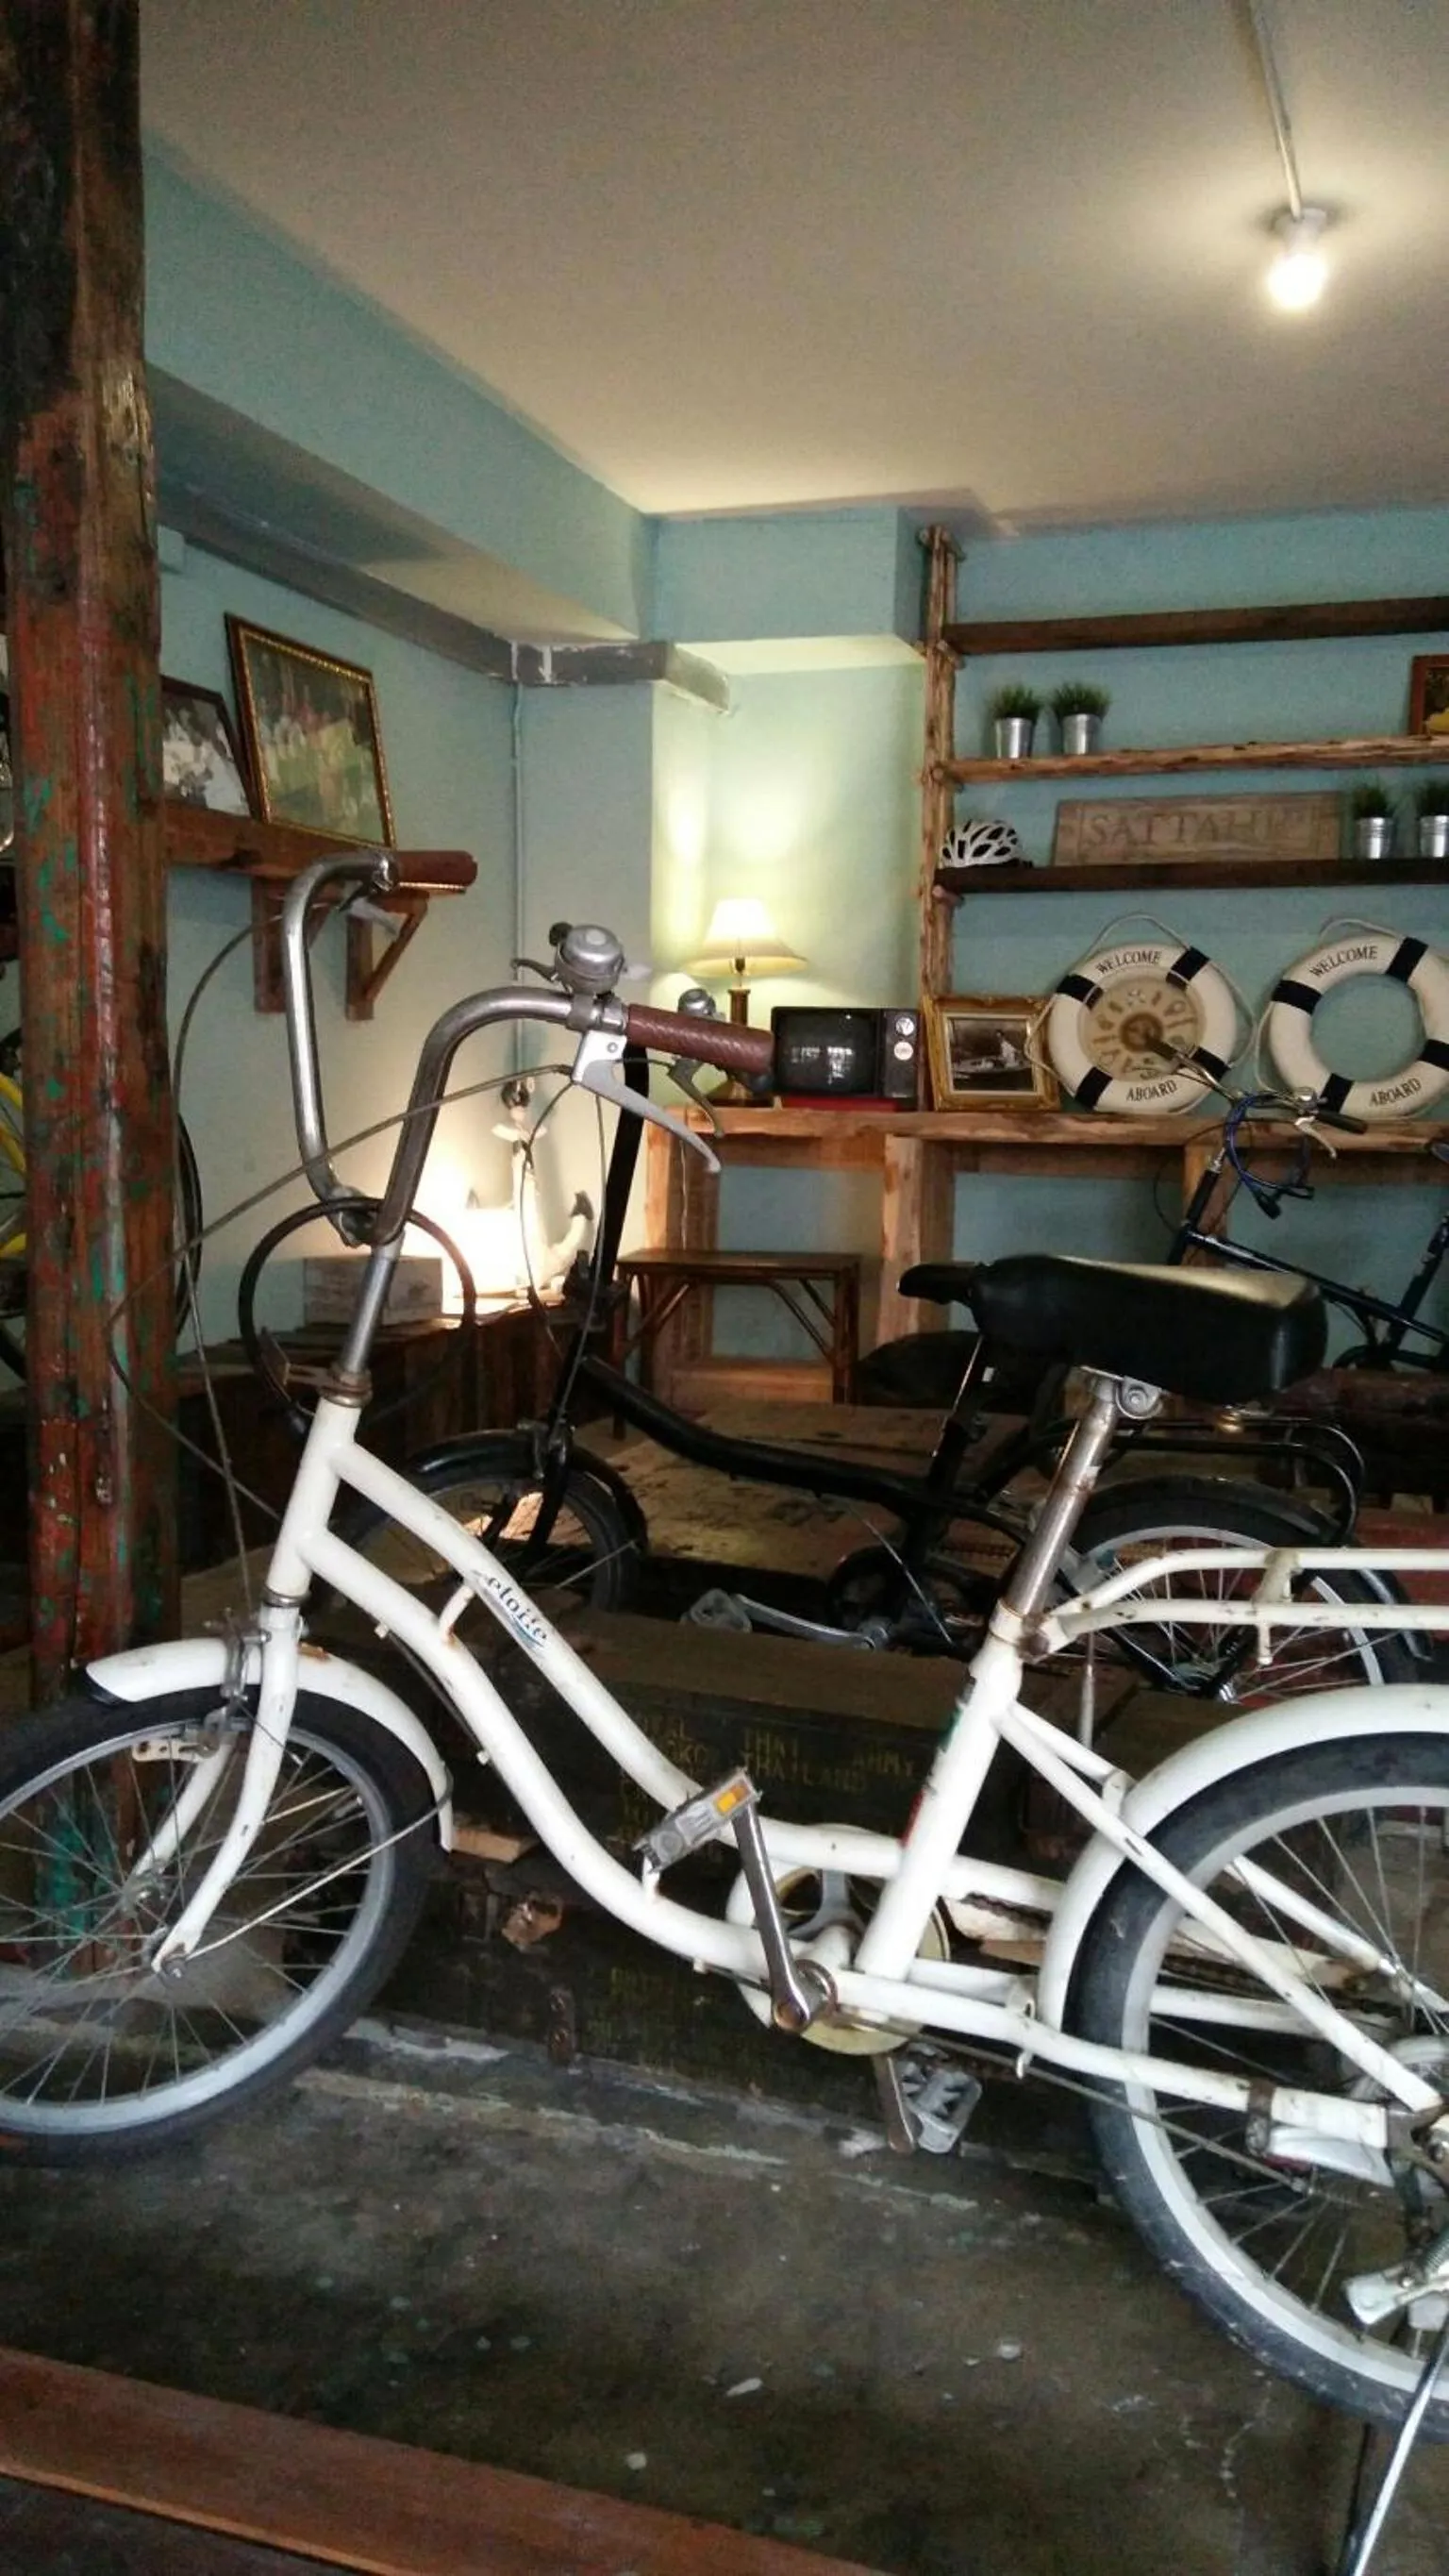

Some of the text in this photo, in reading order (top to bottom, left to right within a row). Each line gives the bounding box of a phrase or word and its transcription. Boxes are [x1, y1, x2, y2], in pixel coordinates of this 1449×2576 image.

[1096, 951, 1162, 975] WELCOME
[1310, 945, 1377, 977] WELCOME
[1126, 1079, 1177, 1102] ABOARD
[1369, 1079, 1423, 1106] ABOARD
